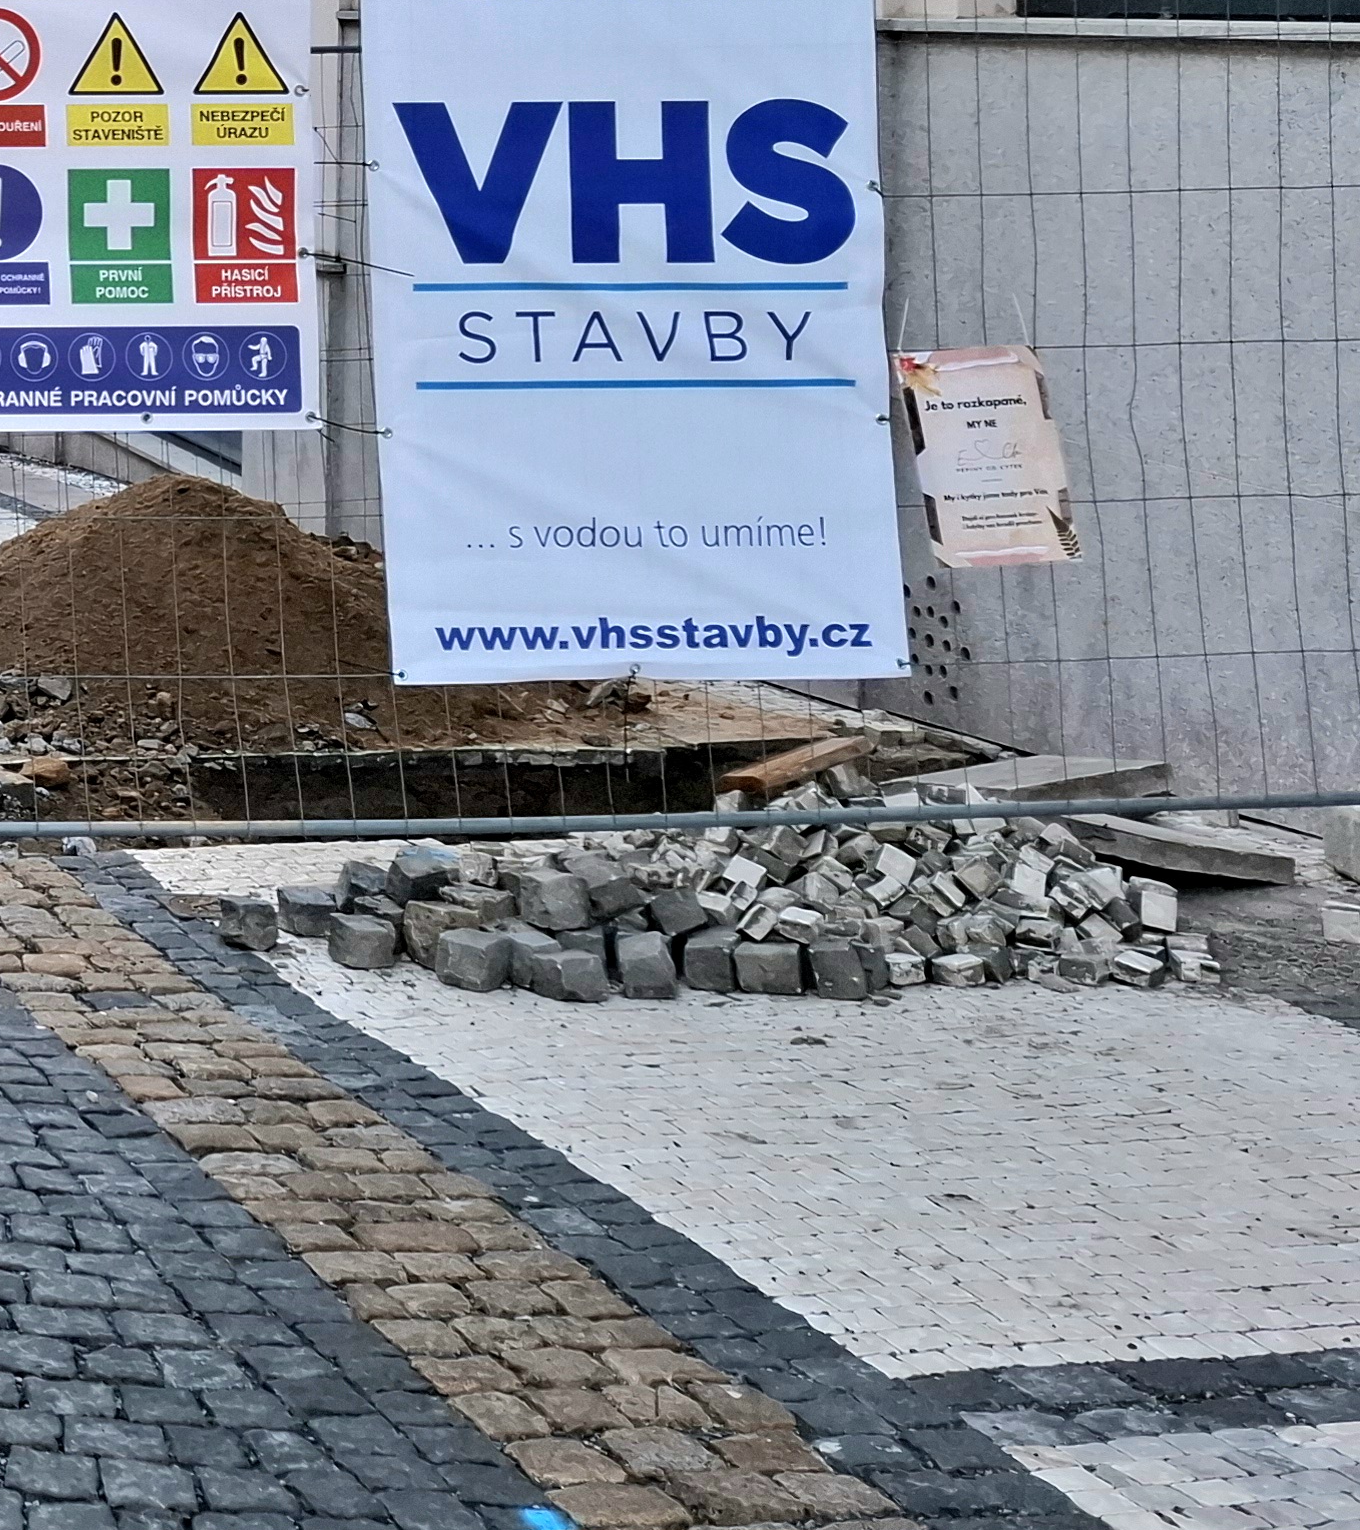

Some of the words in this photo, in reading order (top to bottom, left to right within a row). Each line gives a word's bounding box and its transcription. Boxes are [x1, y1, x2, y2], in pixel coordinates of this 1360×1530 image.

[90, 111, 144, 123] POZOR
[199, 107, 286, 122] NEBEZPEČÍ
[72, 125, 164, 141] STAVENIŠTĚ
[216, 124, 269, 139] ÚRAZU
[392, 98, 857, 266] VHS
[99, 267, 142, 282] PRVNÍ
[221, 266, 269, 282] HASICÍ
[95, 286, 149, 299] POMOC
[211, 283, 281, 298] PŘÍSTROJ
[458, 310, 814, 365] STAVBY
[70, 386, 176, 408] PRACOVNÍ
[184, 384, 288, 407] POMŮCKY
[924, 400, 938, 412] Je
[941, 399, 954, 410] to
[966, 420, 982, 429] MY
[984, 419, 998, 428] NE
[508, 526, 522, 549] s
[533, 516, 643, 549] vodou
[651, 520, 689, 549] to
[702, 514, 828, 549] umíme!
[435, 615, 874, 658] www.vhsstavby.cz
